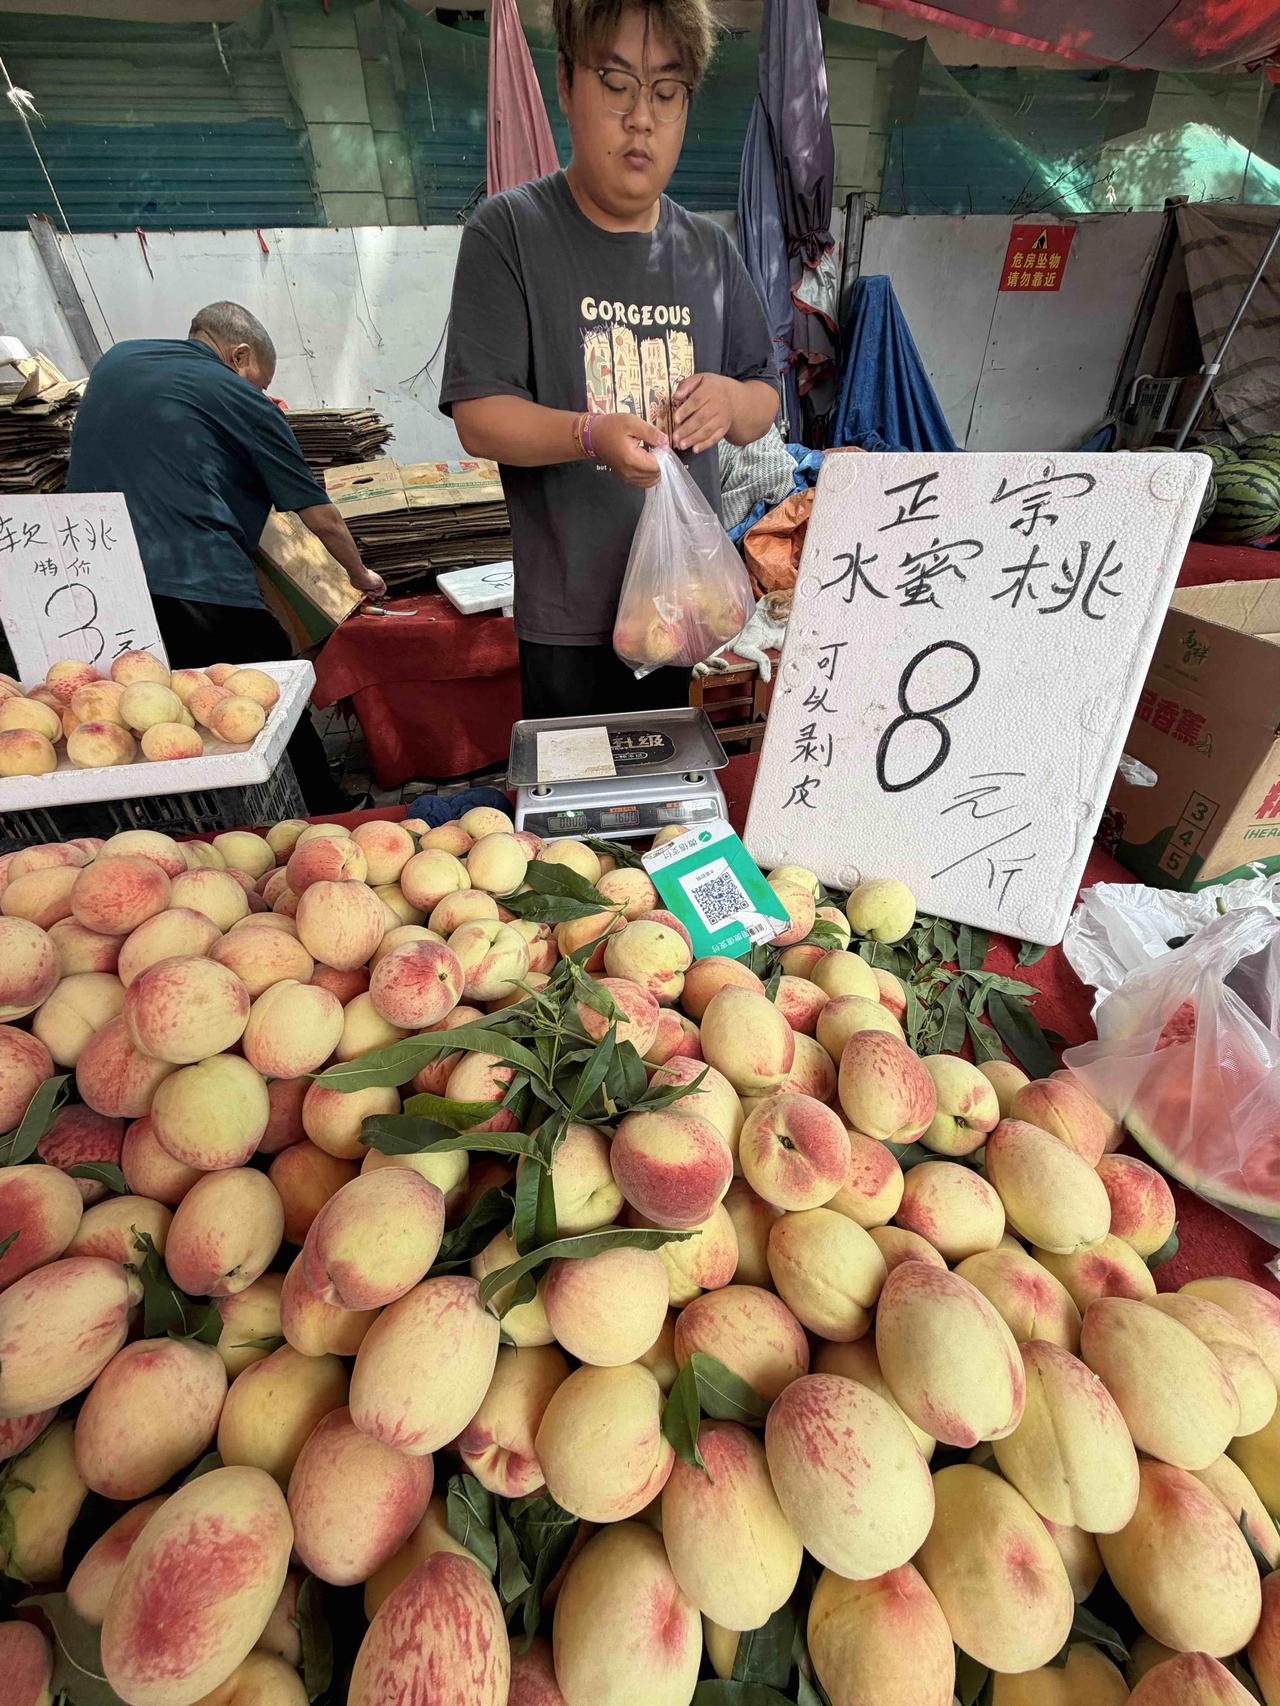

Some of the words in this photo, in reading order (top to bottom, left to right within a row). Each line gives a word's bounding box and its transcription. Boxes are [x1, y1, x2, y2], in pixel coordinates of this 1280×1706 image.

[1011, 252, 1061, 269] 危房坠物
[1007, 271, 1056, 287] 请勿靠近
[581, 297, 691, 326] GORGEOUS
[878, 466, 1096, 536] 正宗
[0, 516, 117, 553] 软桃
[34, 557, 91, 576] 特价
[821, 538, 1123, 619] 水蜜桃
[781, 642, 848, 809] 可以剥皮
[876, 640, 980, 792] 8
[1191, 802, 1209, 822] 3
[663, 838, 698, 859] 微信支付
[1178, 829, 1194, 847] 4
[1167, 852, 1183, 871] 5
